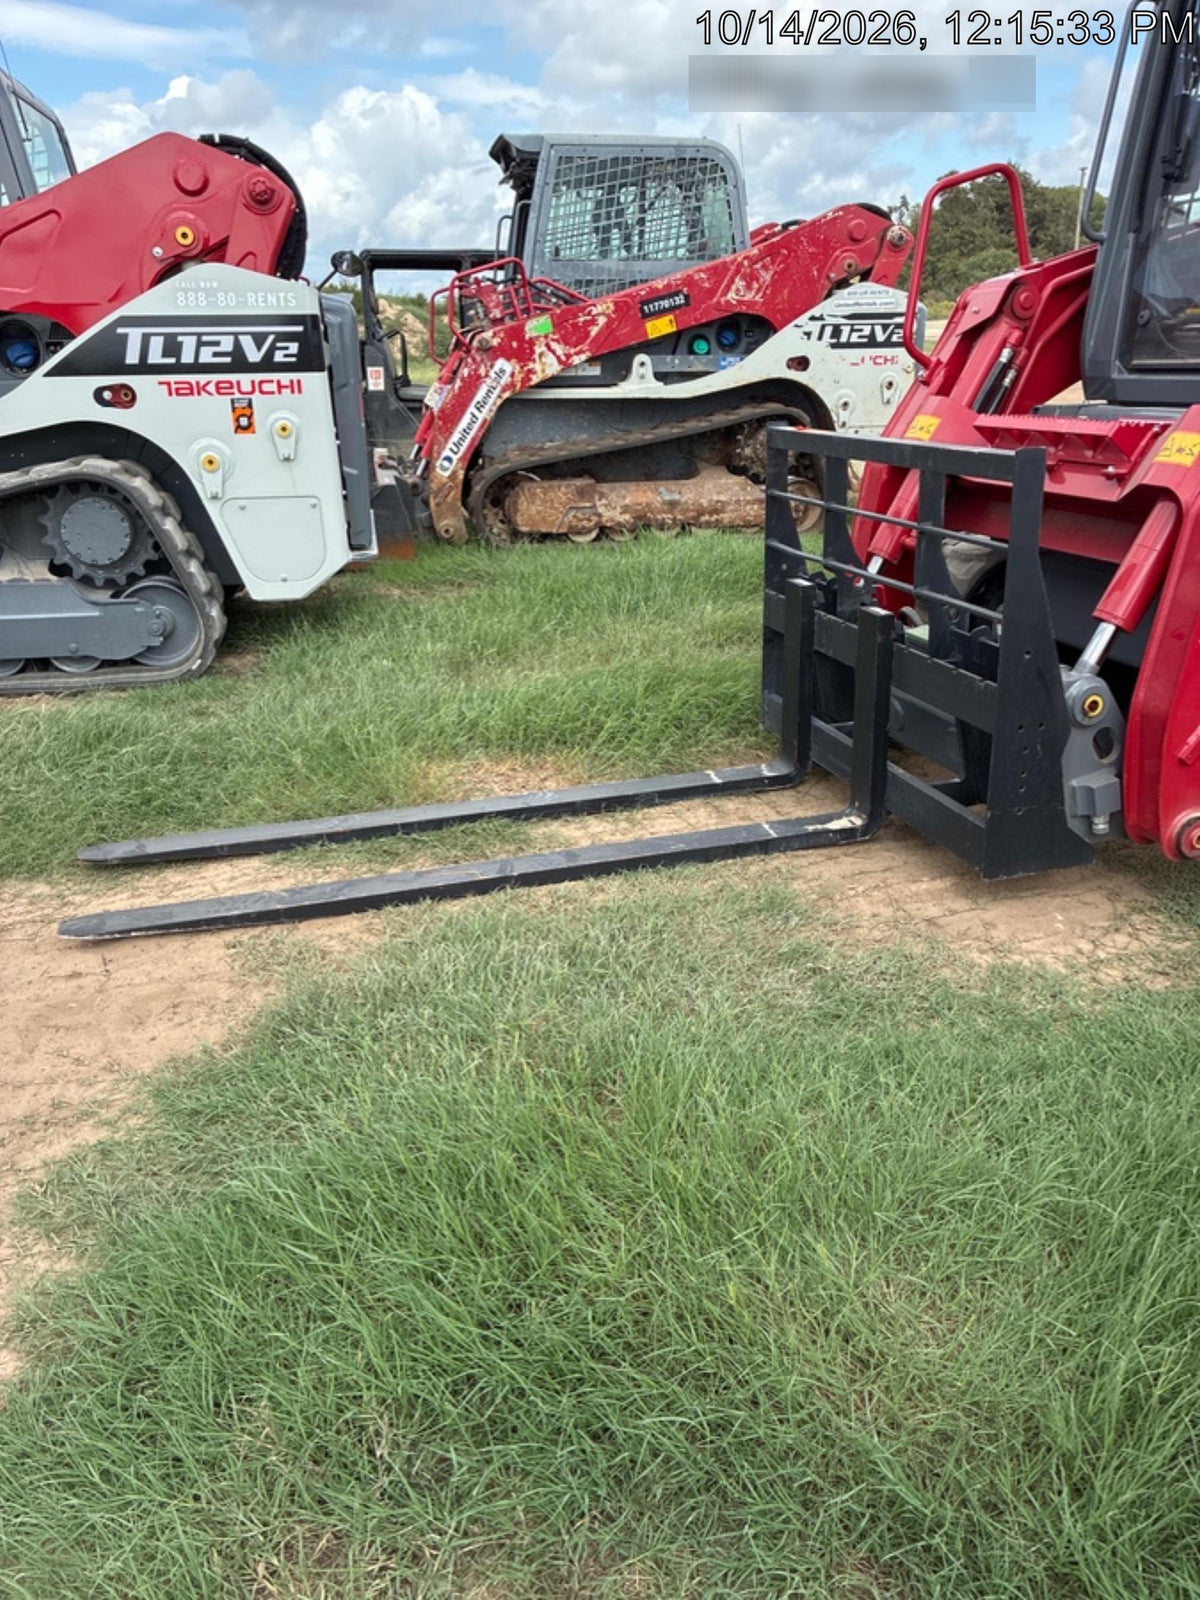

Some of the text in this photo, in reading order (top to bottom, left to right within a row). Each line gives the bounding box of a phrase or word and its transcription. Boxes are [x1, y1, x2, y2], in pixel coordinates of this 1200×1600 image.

[176, 292, 297, 307] 888-80-RENTS
[117, 326, 304, 365] TL12V2
[449, 367, 507, 456] United Rentls
